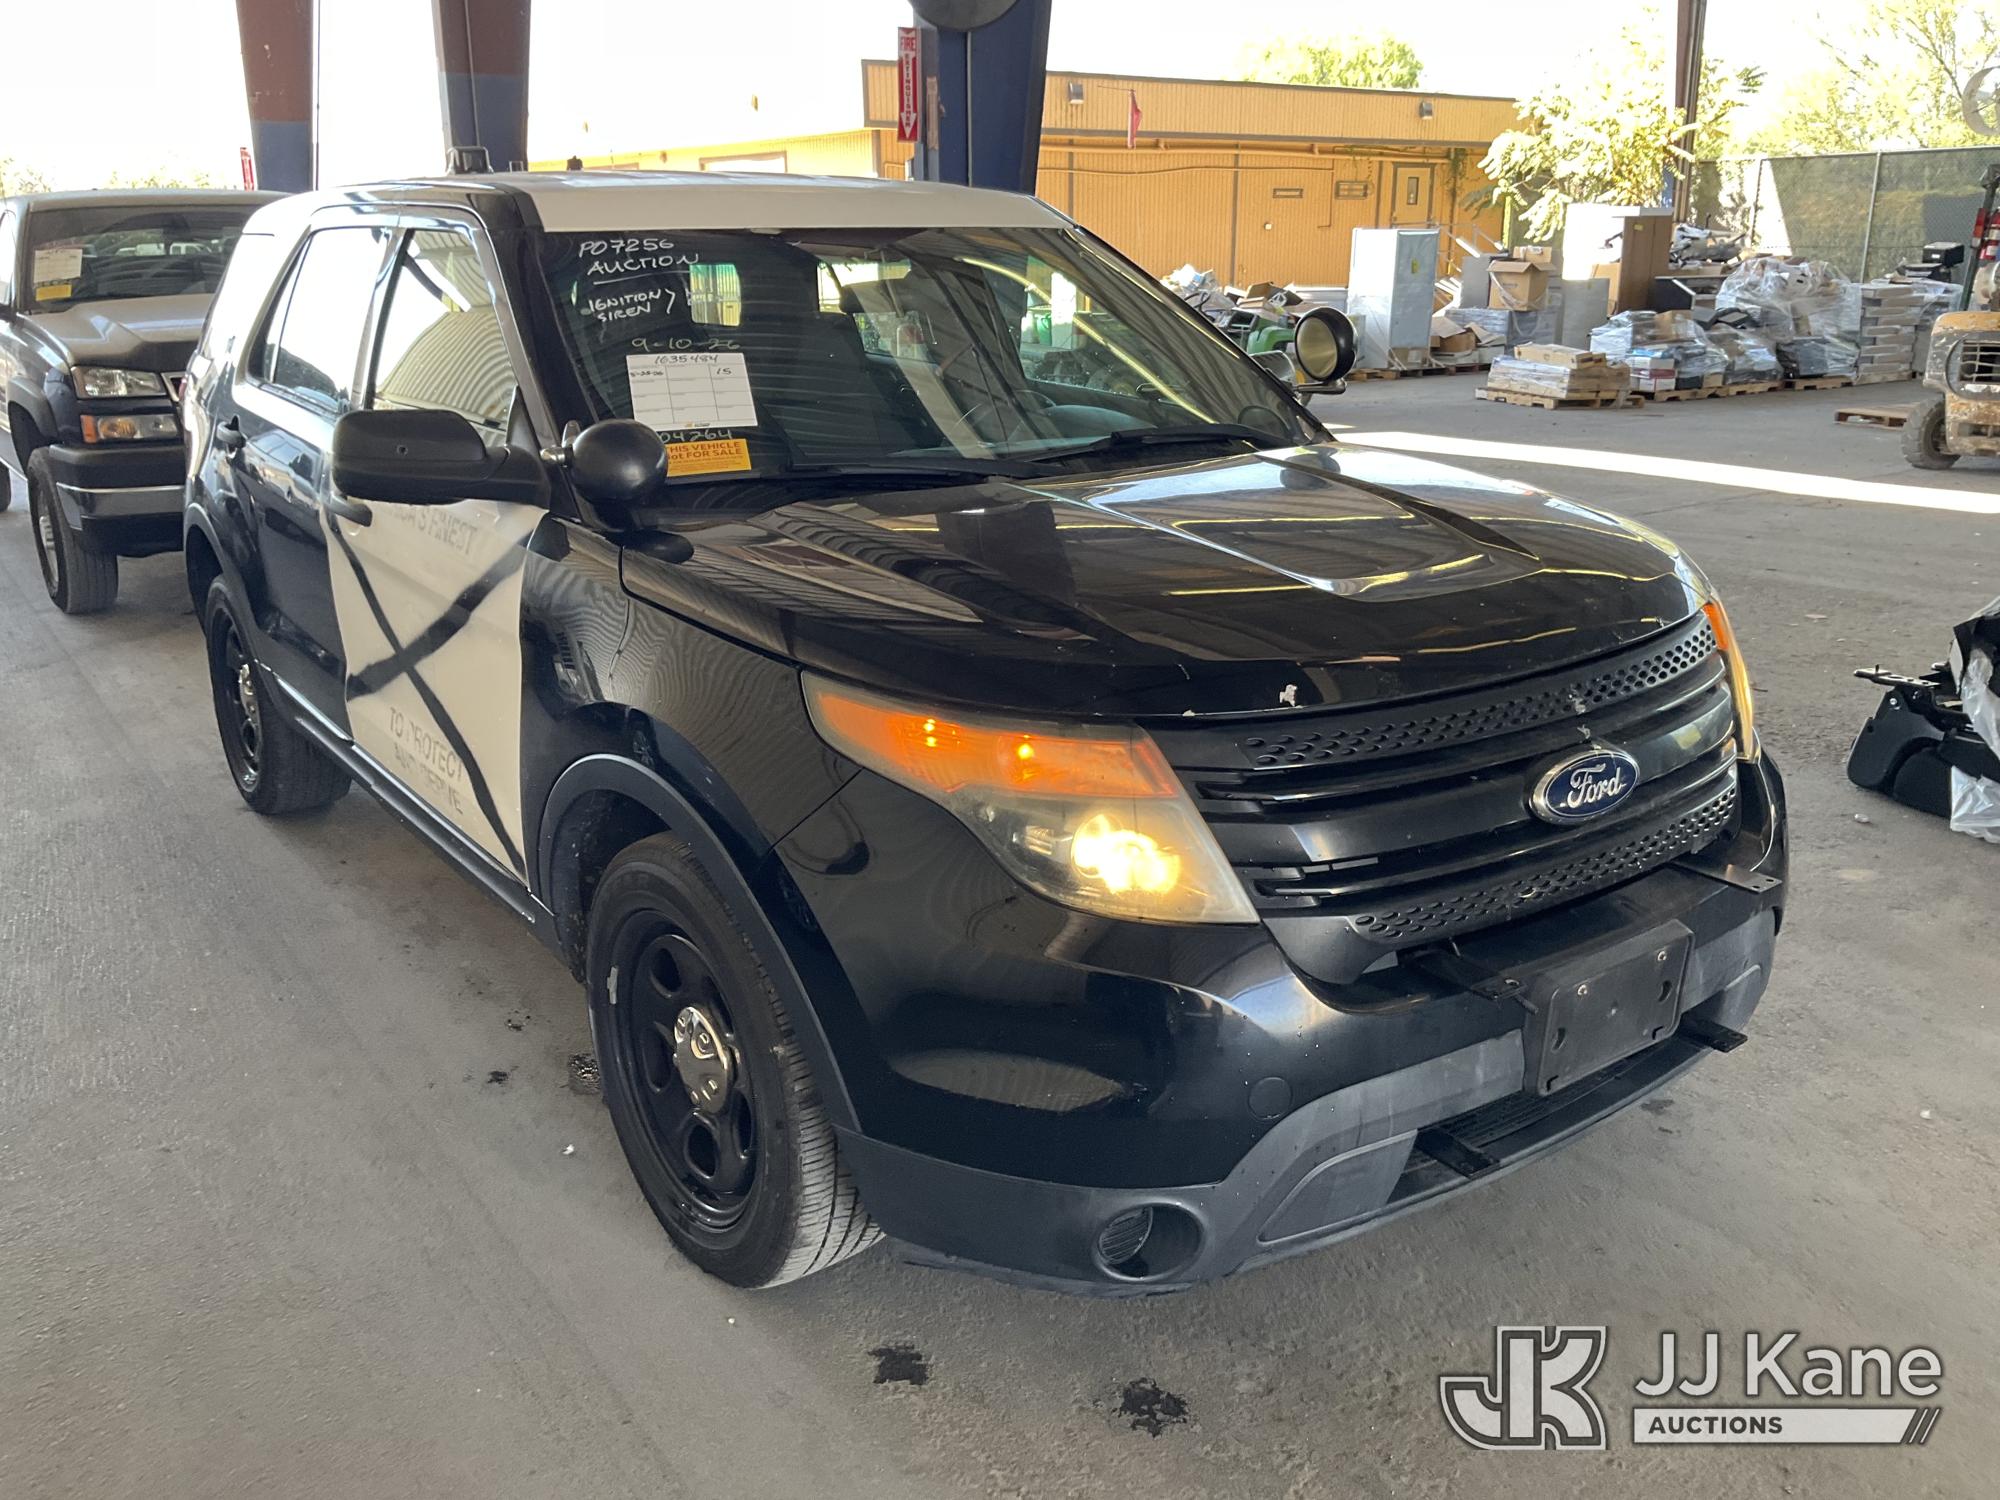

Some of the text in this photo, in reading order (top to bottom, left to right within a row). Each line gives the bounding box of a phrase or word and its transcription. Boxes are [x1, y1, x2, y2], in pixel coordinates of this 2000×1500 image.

[900, 36, 917, 51] FIRE
[587, 253, 699, 276] AUCTION
[588, 288, 662, 312] IGNITION
[597, 301, 651, 322] SIREN
[669, 441, 741, 453] HIS VEHICLE
[686, 450, 710, 458] FOR
[711, 448, 743, 456] SALE
[390, 706, 404, 738] TO
[1566, 763, 1626, 808] Ford
